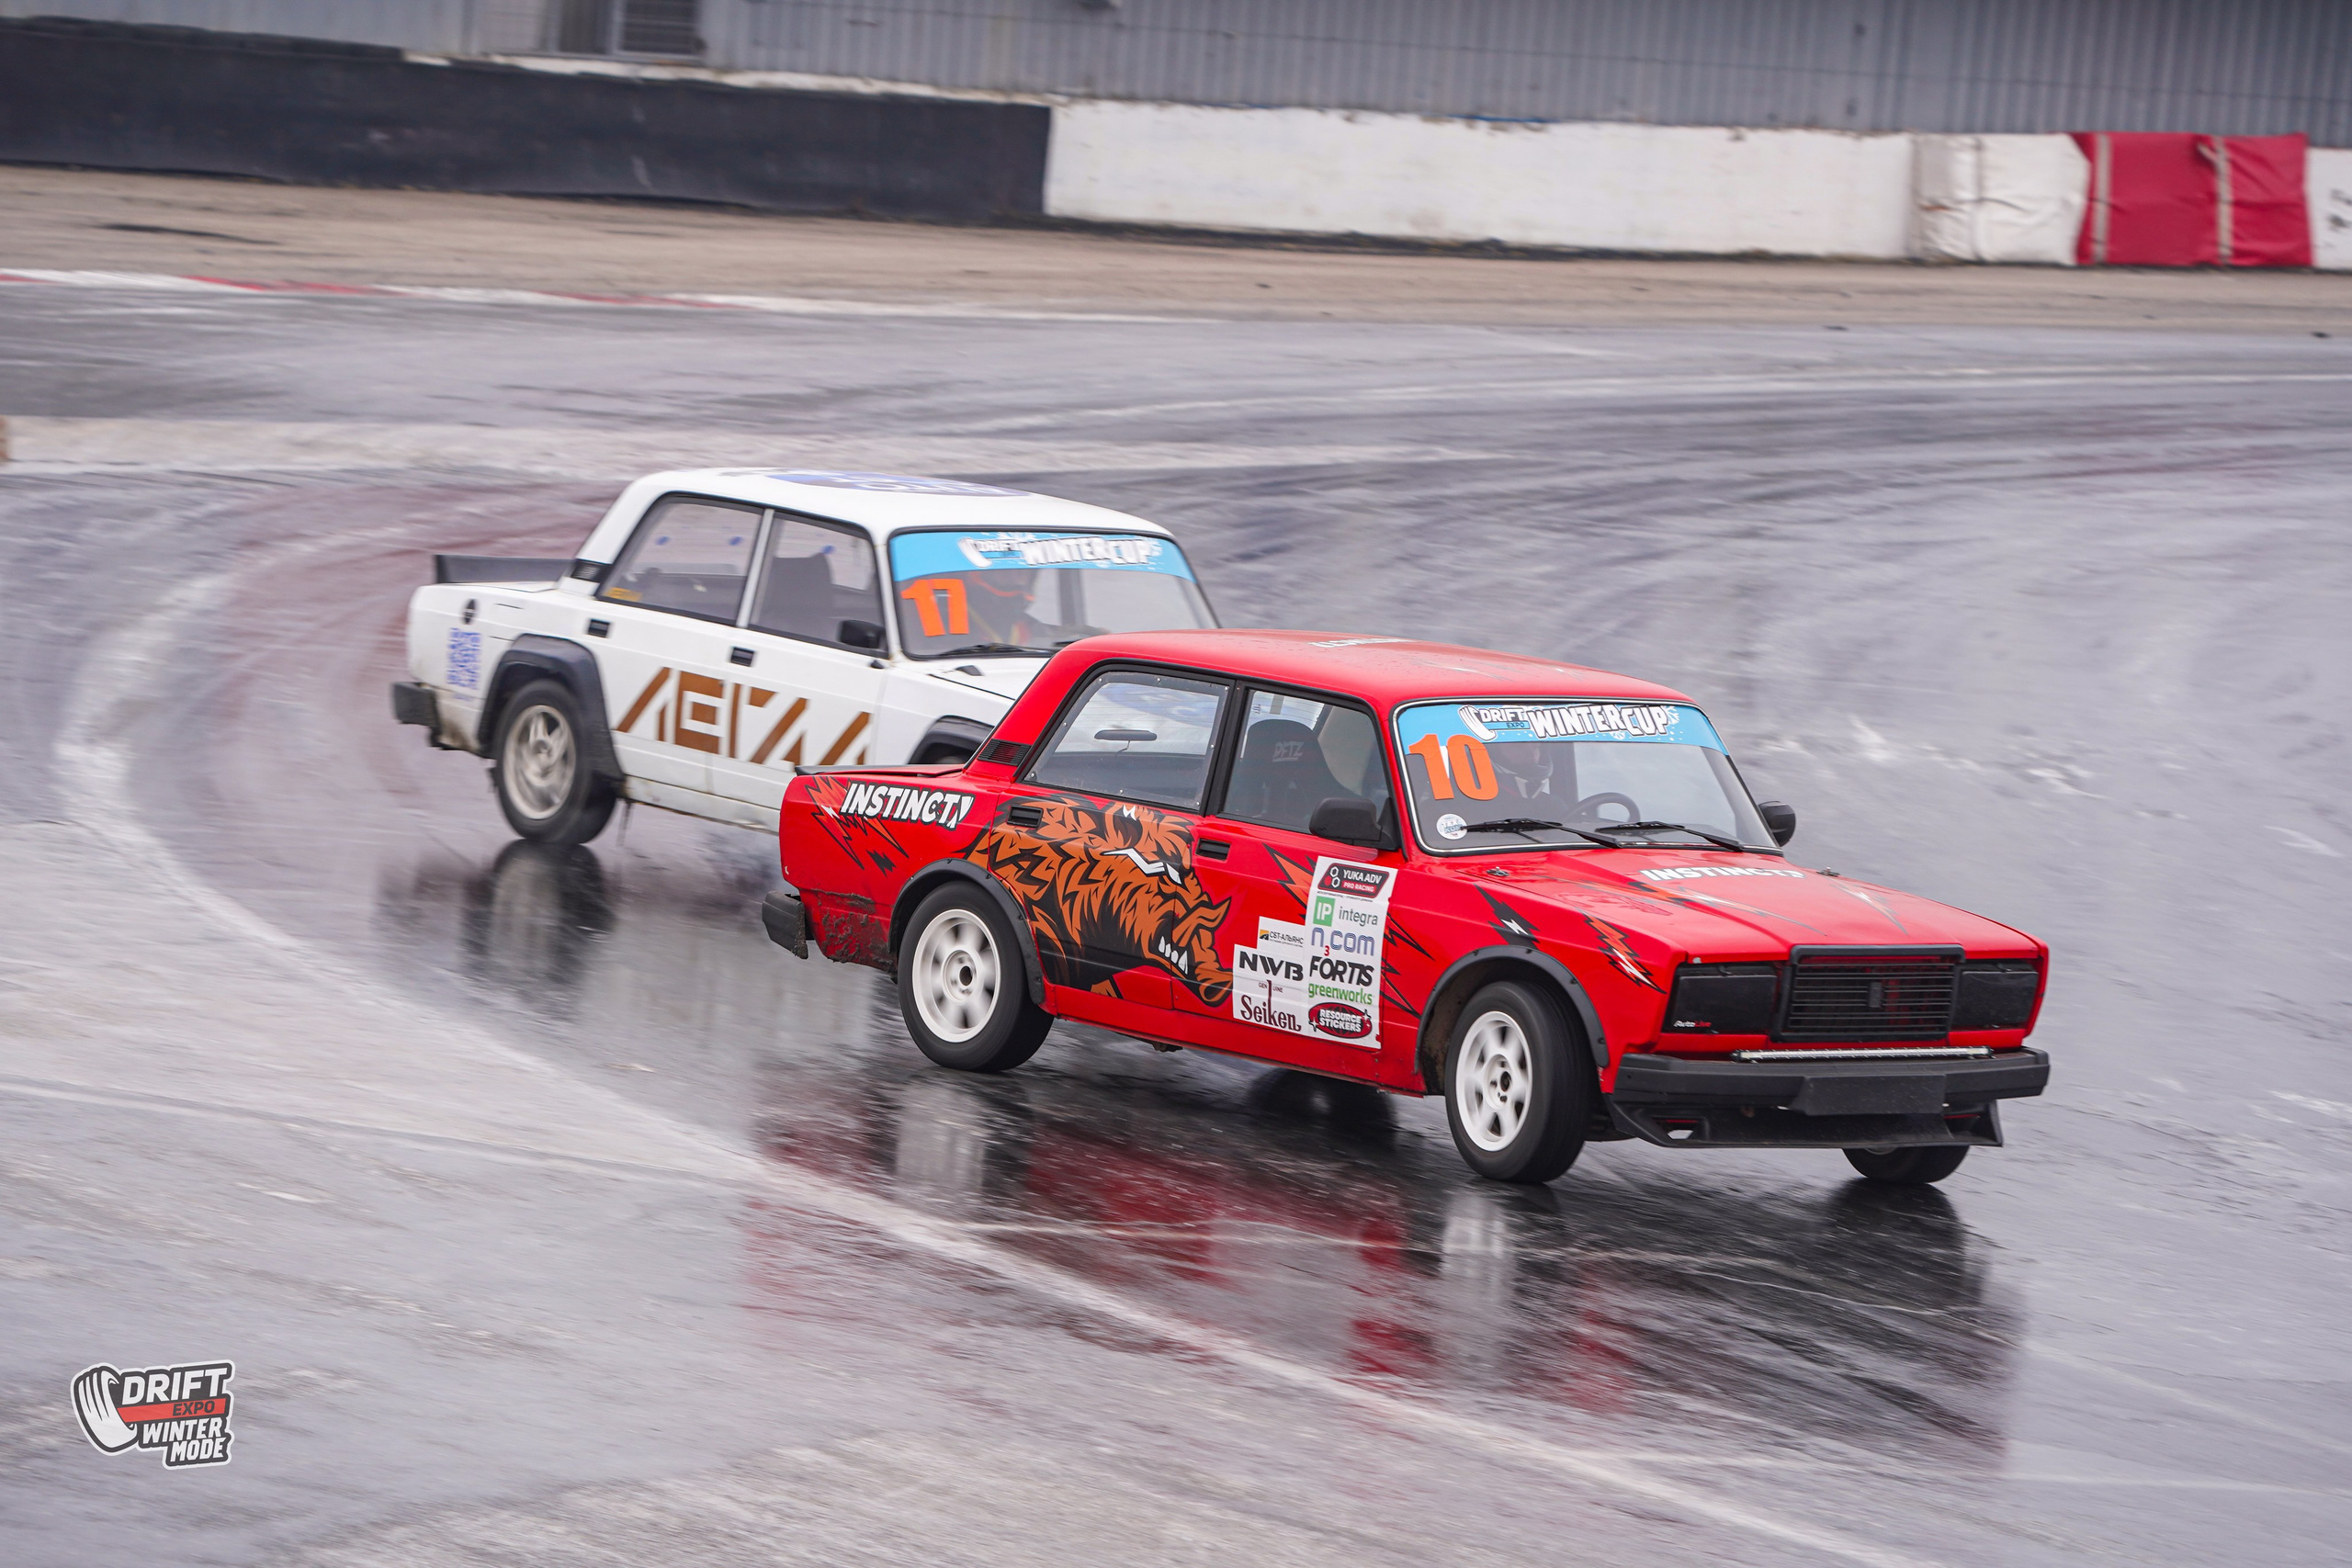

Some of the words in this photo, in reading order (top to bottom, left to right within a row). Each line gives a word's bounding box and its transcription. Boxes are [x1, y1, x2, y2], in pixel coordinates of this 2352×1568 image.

[901, 579, 969, 637] 17
[1480, 707, 1525, 723] DRIFT
[1408, 734, 1499, 801] 10
[1343, 869, 1363, 882] YUKA
[1363, 873, 1383, 885] ADV
[1355, 885, 1375, 893] RACING
[1316, 902, 1332, 920] IP
[1338, 906, 1378, 927] integra
[1238, 951, 1305, 981] NWB
[1309, 955, 1374, 987] FORTIS
[1240, 979, 1302, 1032] Seiken
[1308, 983, 1373, 1005] greenworks
[1318, 1017, 1362, 1032] STICKERS
[1319, 1009, 1363, 1024] RESOURCE
